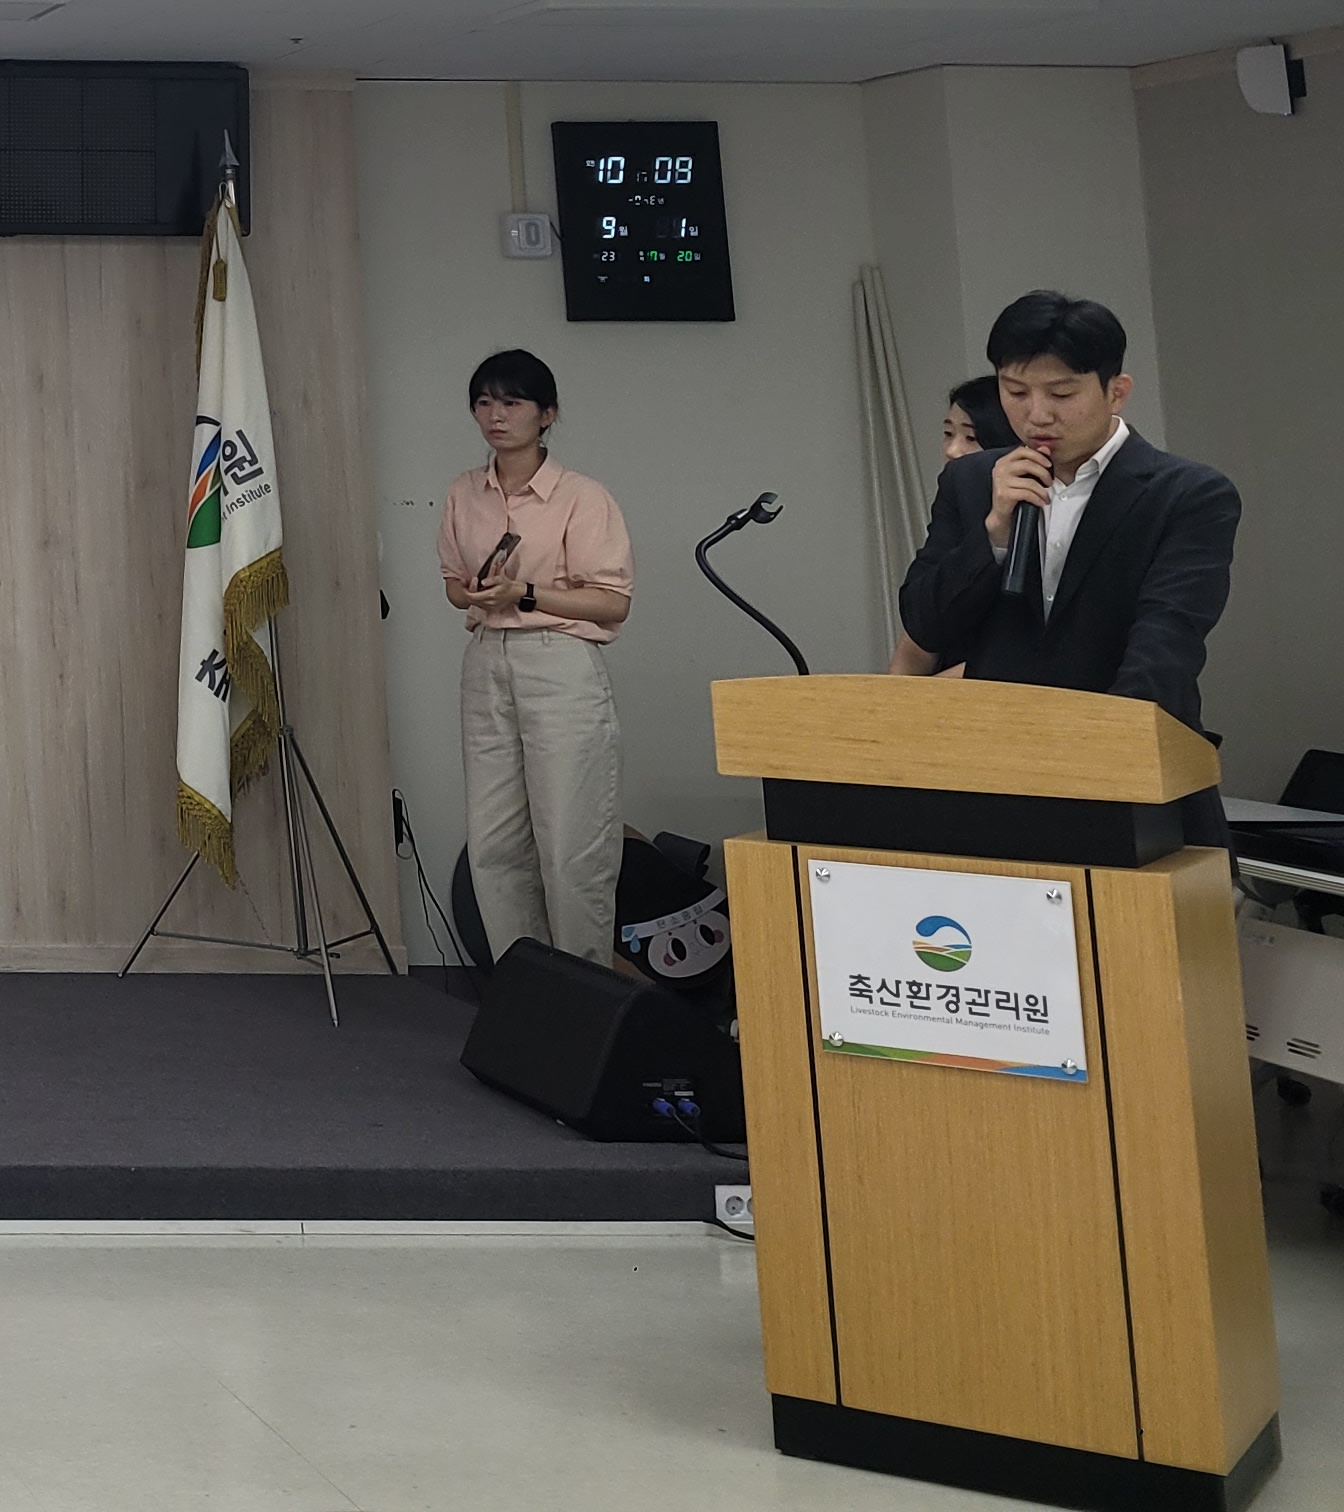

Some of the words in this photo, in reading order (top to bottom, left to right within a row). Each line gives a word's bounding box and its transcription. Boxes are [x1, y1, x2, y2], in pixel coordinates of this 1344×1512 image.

[654, 157, 693, 184] 09
[225, 483, 272, 516] Institute
[848, 974, 1050, 1024] 축산환경관리원
[850, 1005, 890, 1018] Livestock
[891, 1010, 953, 1026] Environmental
[955, 1017, 1012, 1032] Management
[1013, 1024, 1050, 1036] Institute
